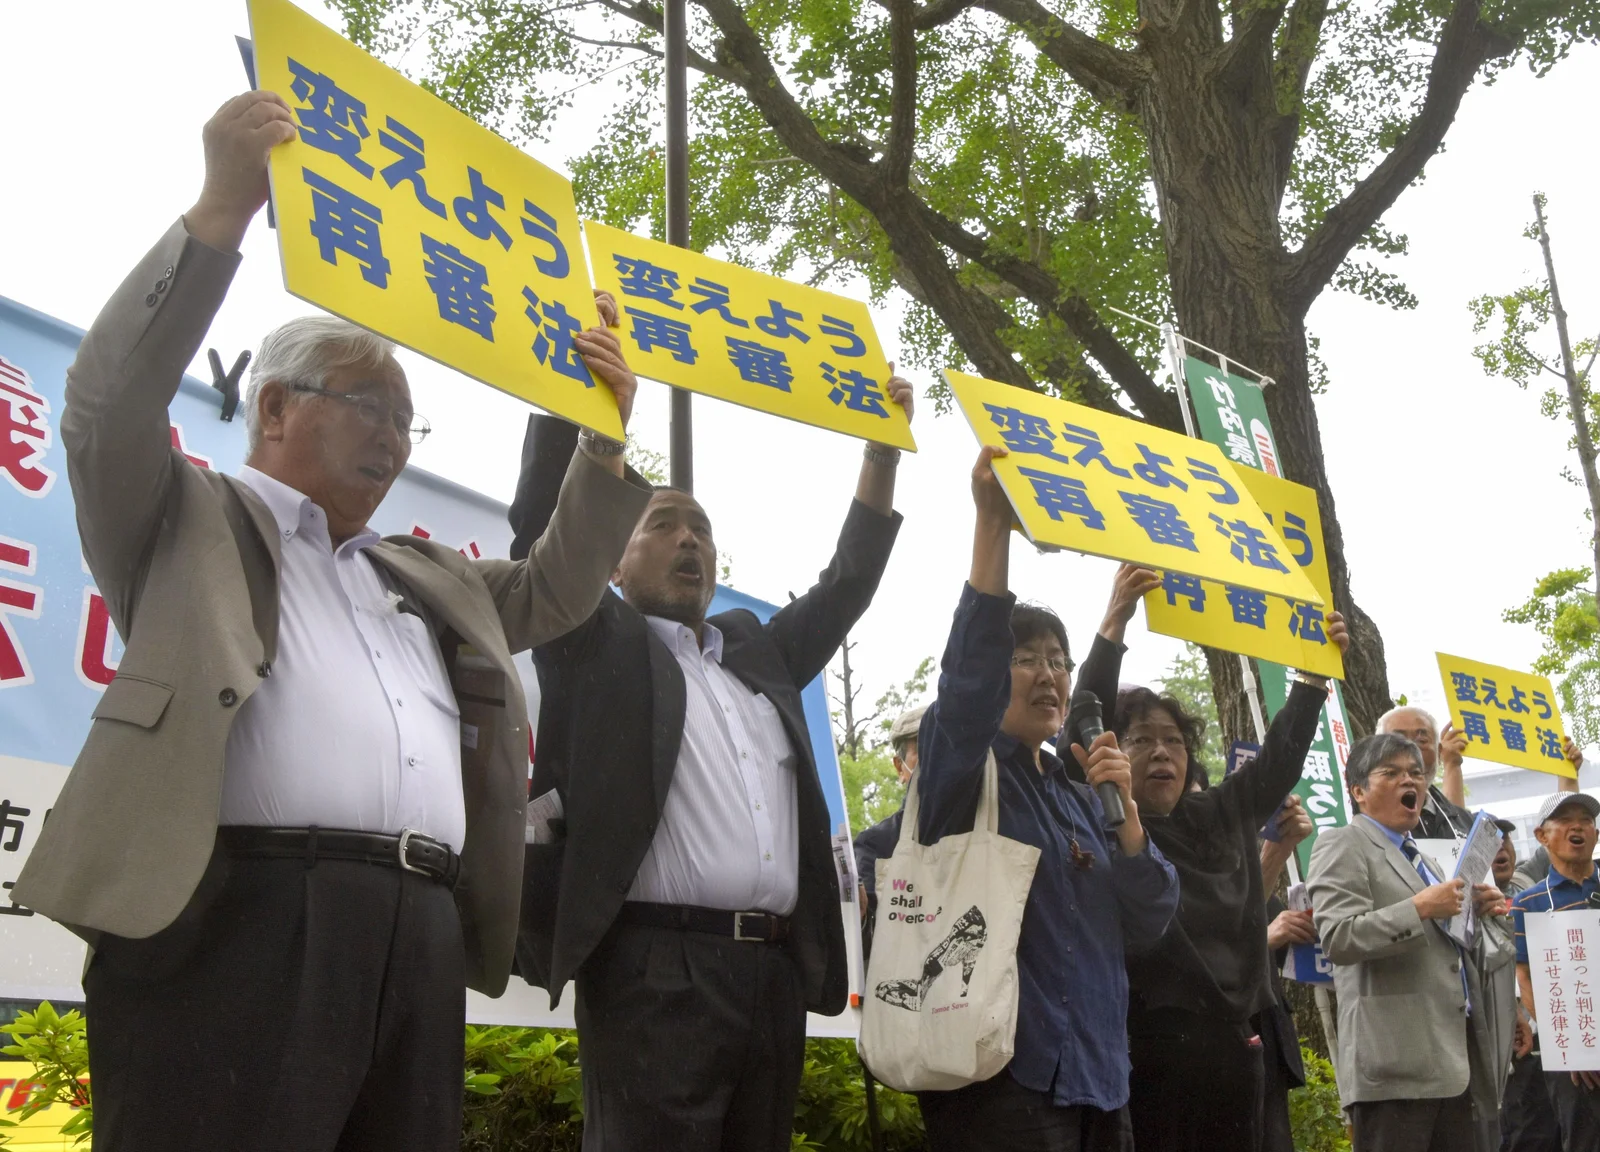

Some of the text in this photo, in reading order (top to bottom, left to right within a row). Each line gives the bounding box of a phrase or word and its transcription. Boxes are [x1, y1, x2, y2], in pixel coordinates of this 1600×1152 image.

[287, 56, 570, 279] 変えよう
[301, 165, 596, 389] 再審法
[612, 253, 867, 358] 変えよう
[623, 305, 891, 419] 再審法
[982, 402, 1240, 505] 変えよう
[1017, 466, 1292, 575] 再審法
[1161, 572, 1328, 646] 再審法
[1450, 671, 1552, 720] 変えよう
[1459, 710, 1565, 761] 再審法
[890, 895, 923, 909] shall
[892, 879, 914, 893] We
[1543, 948, 1570, 1066] 正せる法律を！
[1566, 928, 1597, 1049] 間違った判決を
